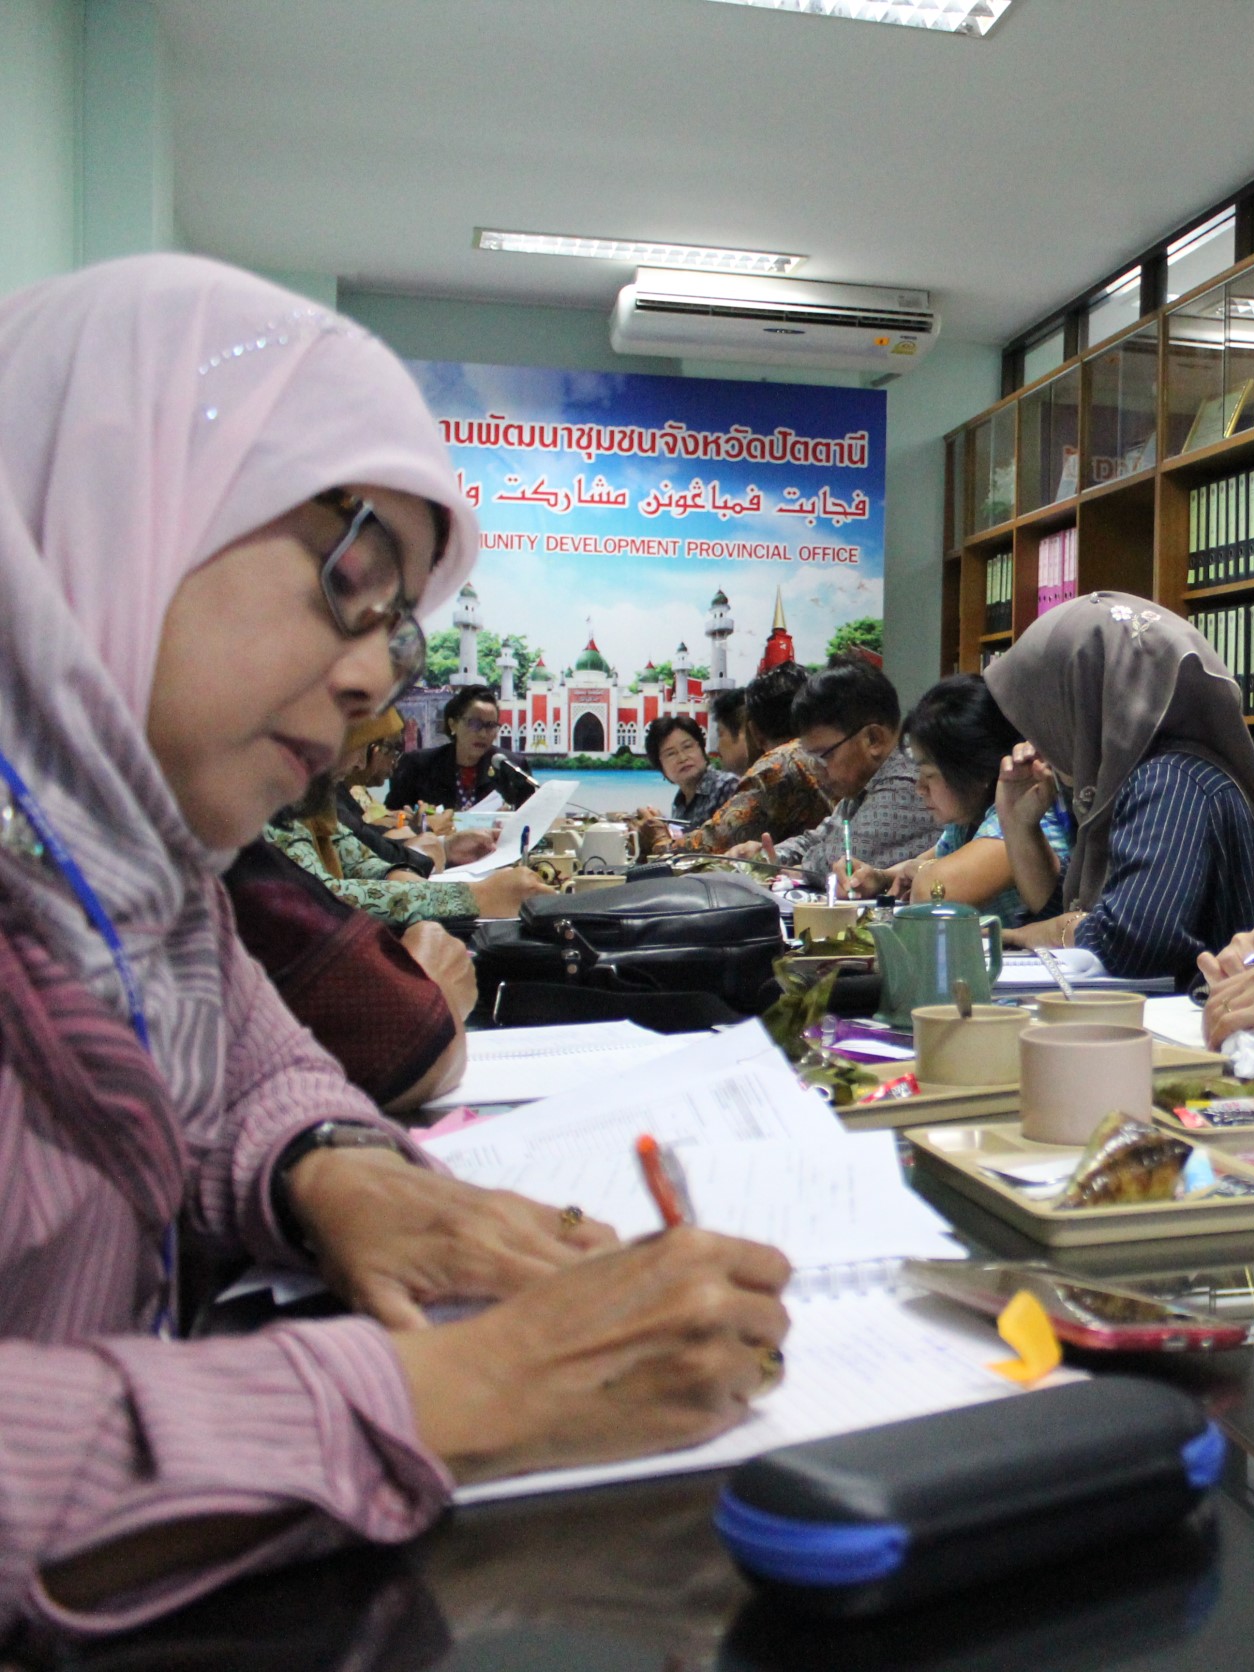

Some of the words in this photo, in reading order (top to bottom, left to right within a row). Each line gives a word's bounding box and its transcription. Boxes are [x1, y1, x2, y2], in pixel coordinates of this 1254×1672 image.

[546, 535, 680, 556] DEVELOPMENT
[686, 541, 792, 560] PROVINCIAL
[799, 545, 859, 563] OFFICE
